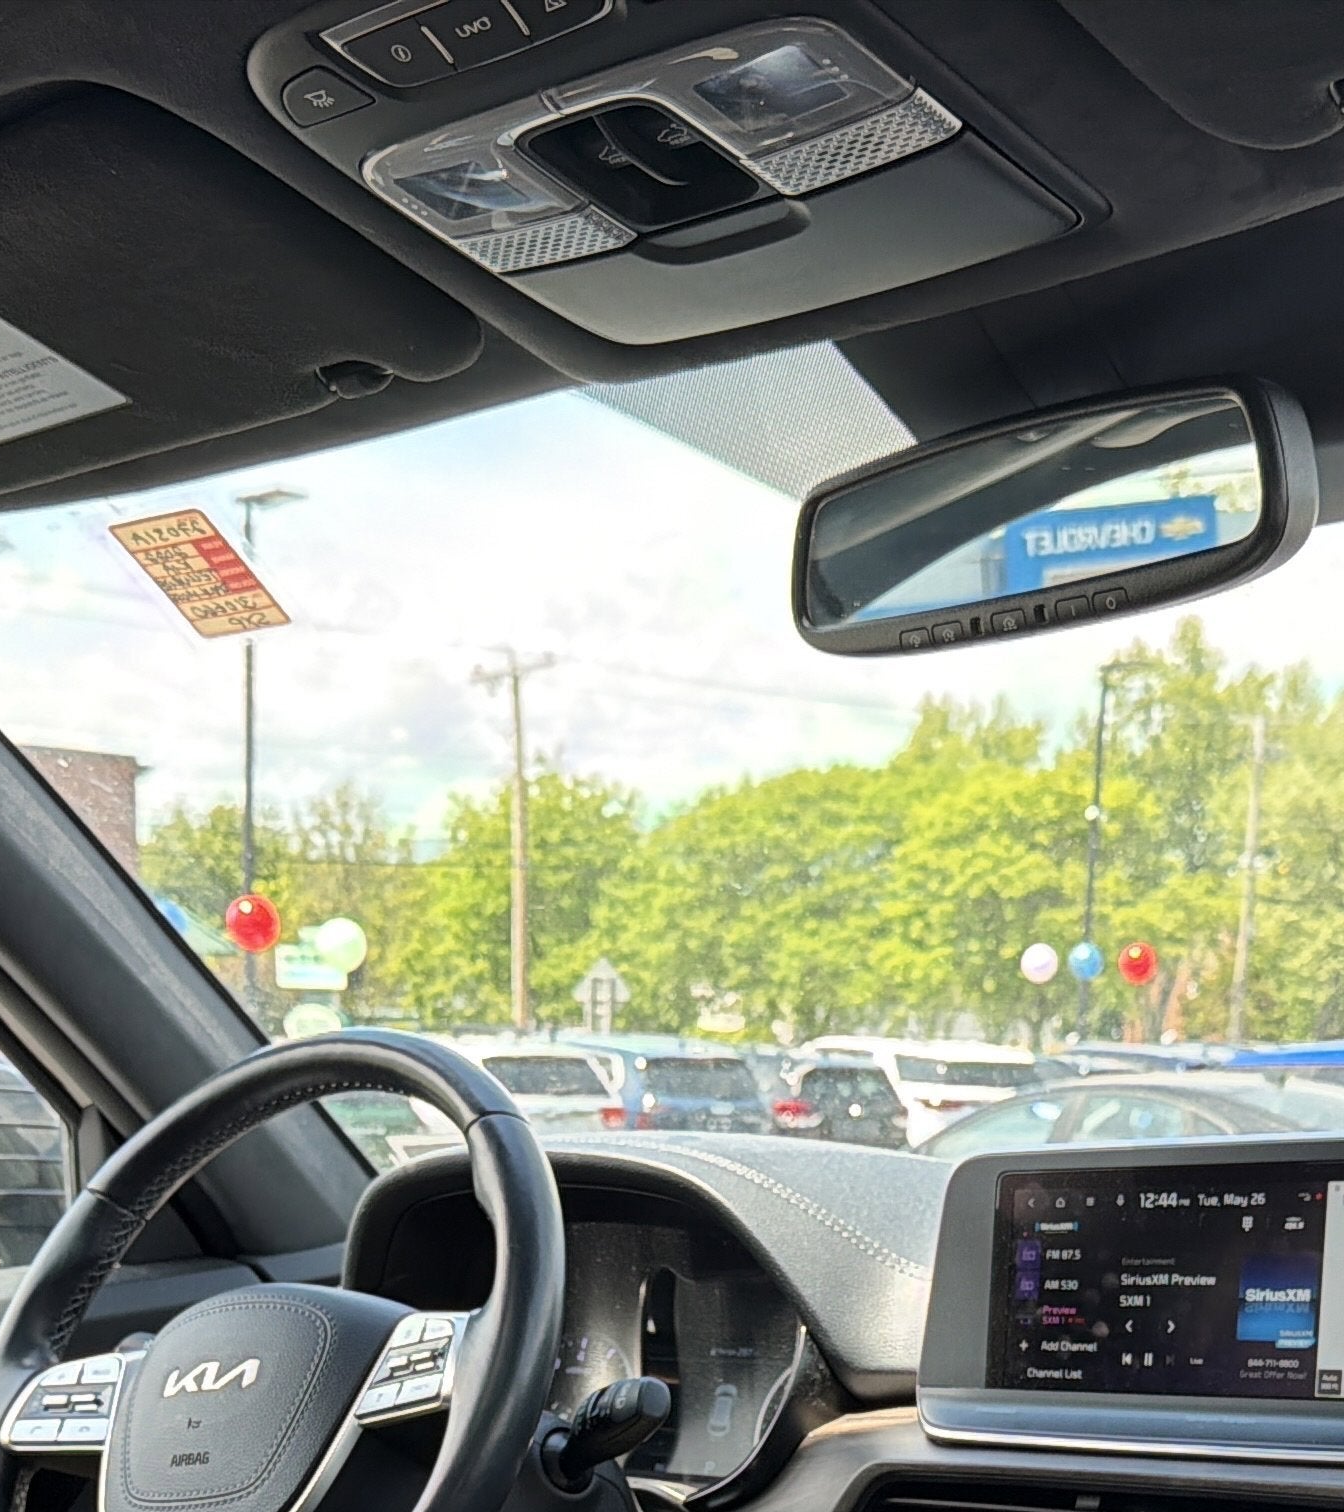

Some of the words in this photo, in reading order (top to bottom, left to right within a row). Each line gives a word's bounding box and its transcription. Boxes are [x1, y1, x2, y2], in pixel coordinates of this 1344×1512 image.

[1139, 1191, 1178, 1209] 12:44
[1224, 1193, 1248, 1208] May
[1251, 1192, 1266, 1206] 26
[1046, 1250, 1060, 1260] FM
[1061, 1250, 1081, 1261] 87.5
[1044, 1280, 1060, 1291] AM
[1060, 1280, 1078, 1291] 530
[1121, 1274, 1169, 1287] SiriusXM
[1172, 1274, 1216, 1287] Preview
[1119, 1295, 1144, 1307] SXM
[1245, 1288, 1312, 1303] SiriusXM
[1041, 1340, 1059, 1351] Add
[1060, 1341, 1098, 1352] Channel
[163, 1358, 261, 1398] KIA
[1027, 1367, 1063, 1379] Channel
[1064, 1368, 1083, 1380] List
[170, 1451, 210, 1468] AIRBAG
